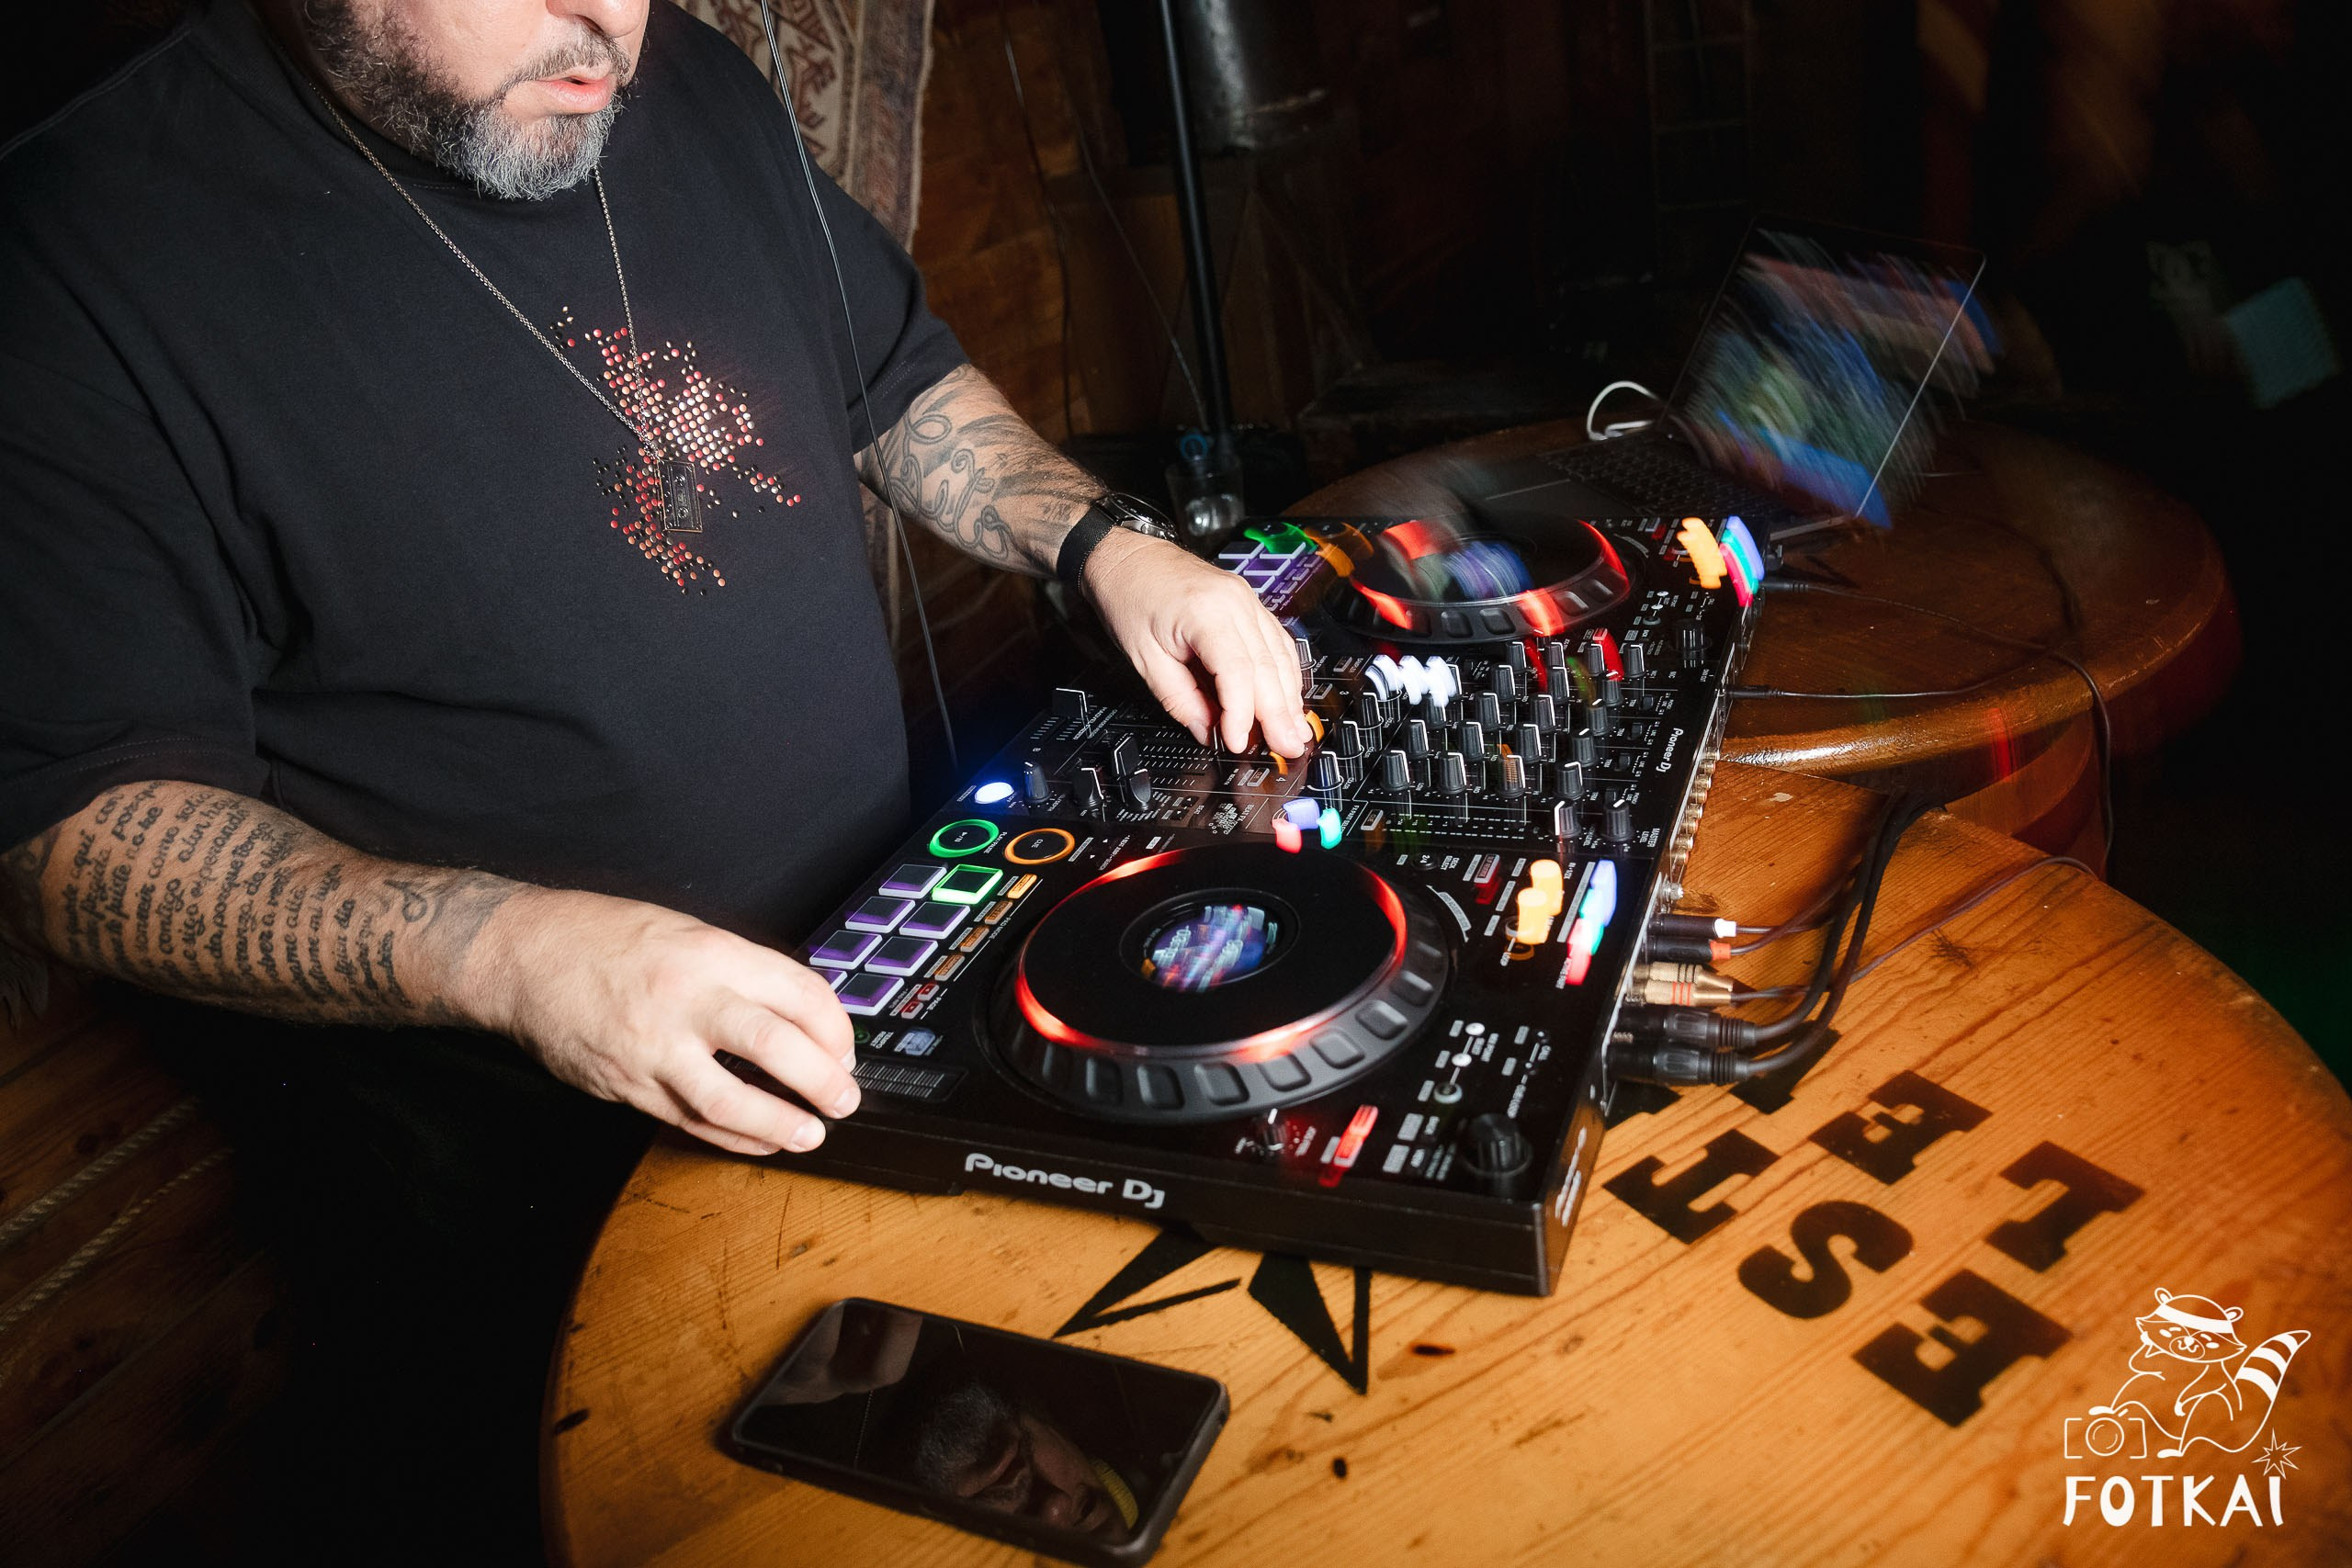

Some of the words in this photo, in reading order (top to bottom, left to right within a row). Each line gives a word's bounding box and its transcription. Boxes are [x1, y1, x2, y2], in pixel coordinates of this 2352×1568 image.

[1665, 728, 1683, 761] Pioneer
[1275, 774, 1285, 784] 4
[982, 831, 1008, 852] PLAY/PAUSE
[1030, 839, 1044, 848] CUE
[1646, 828, 1659, 847] MASTER
[965, 1153, 1114, 1195] Pioneer
[1122, 1179, 1166, 1210] DJ
